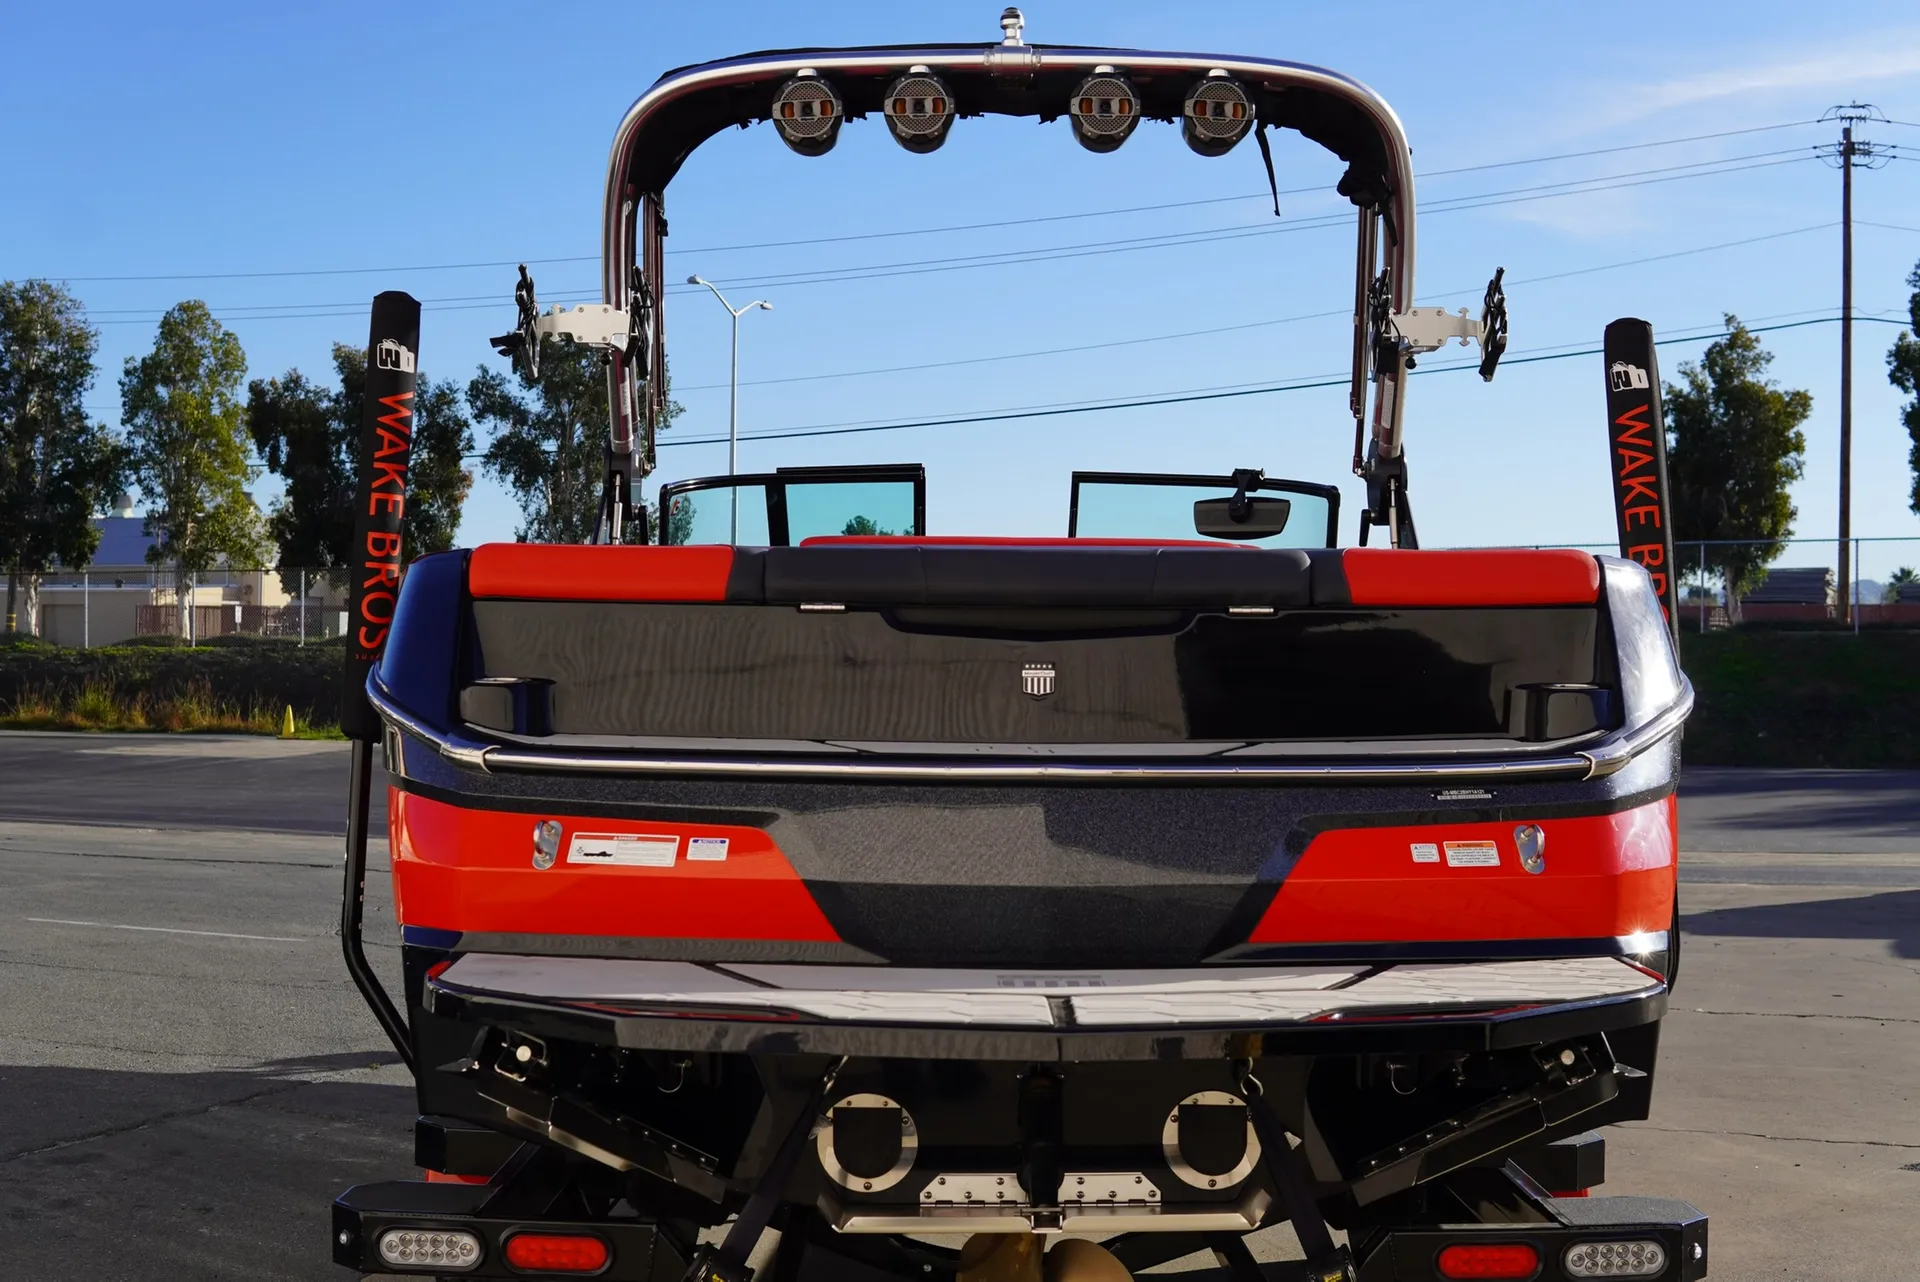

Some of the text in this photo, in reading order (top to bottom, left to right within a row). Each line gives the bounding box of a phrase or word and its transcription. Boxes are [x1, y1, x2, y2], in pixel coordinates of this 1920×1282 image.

[358, 391, 415, 649] WAKE BROS
[1615, 403, 1662, 532] WAKE
